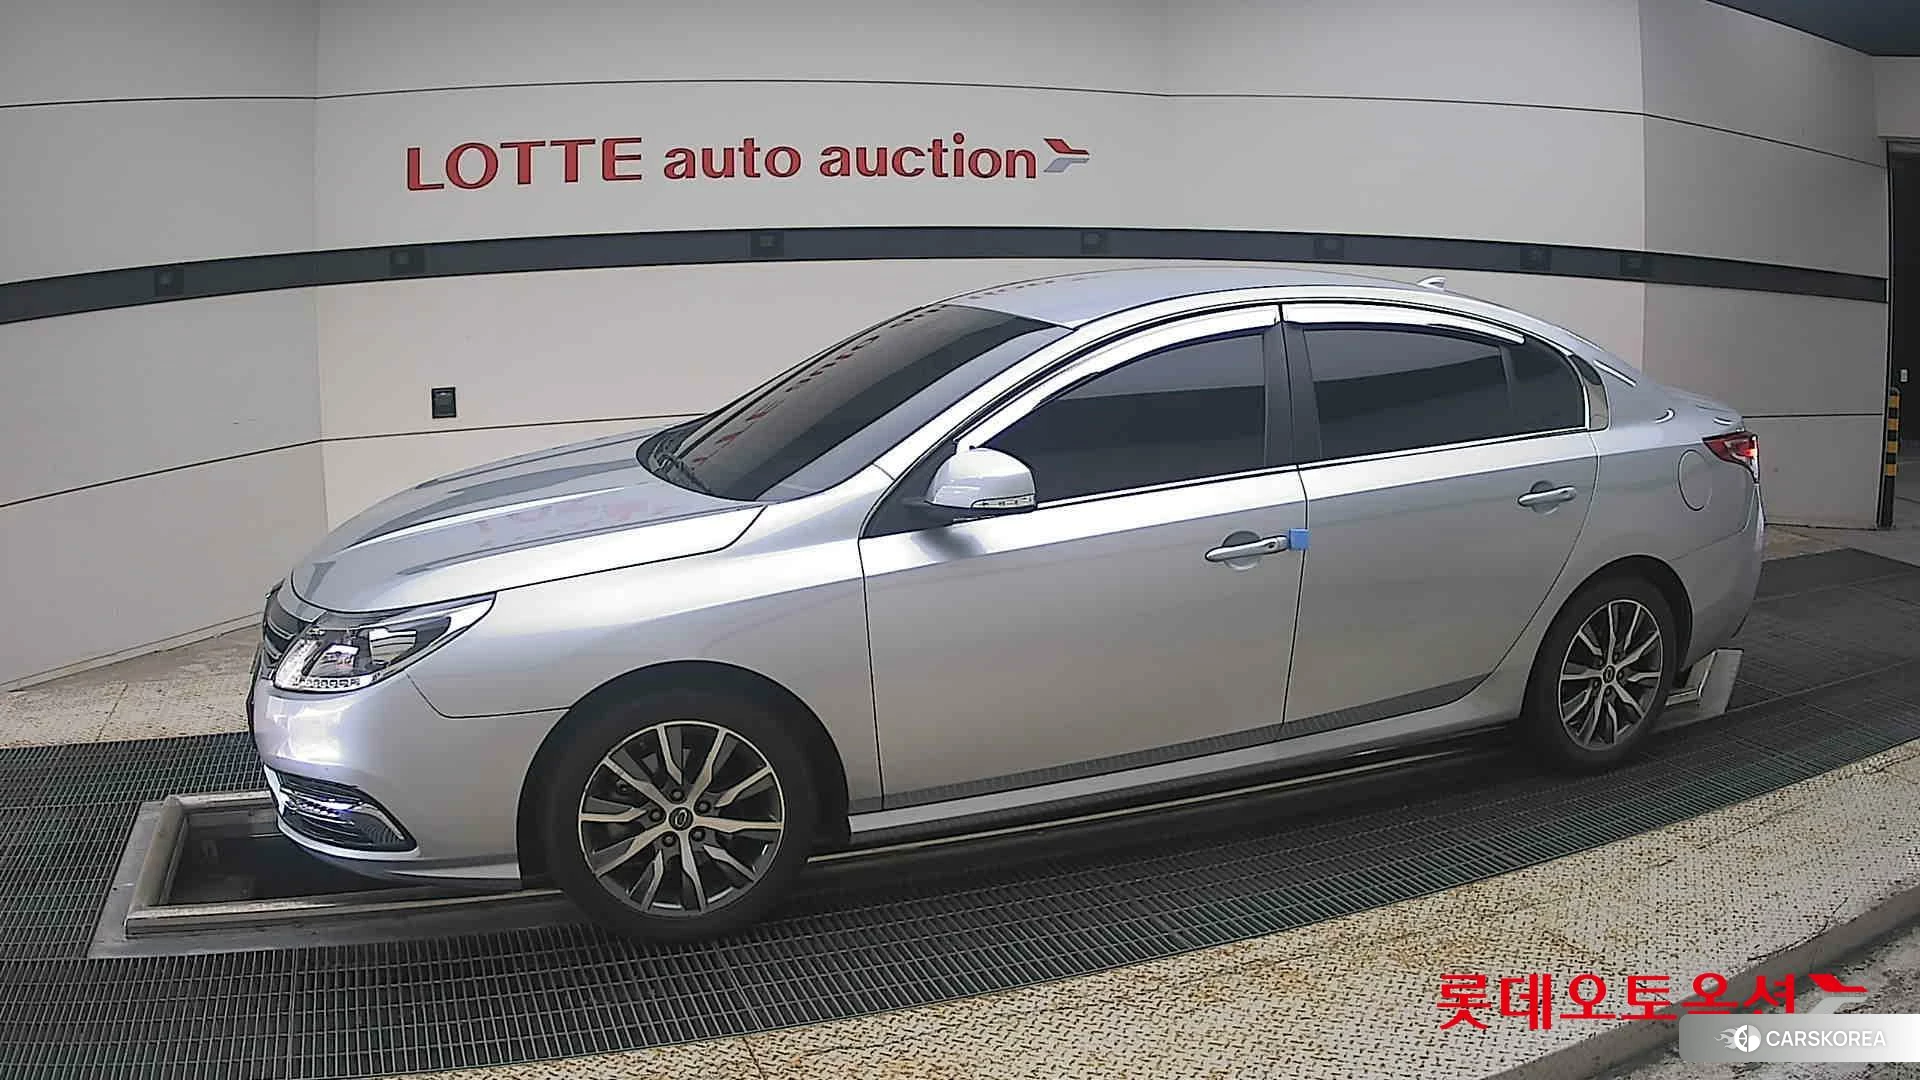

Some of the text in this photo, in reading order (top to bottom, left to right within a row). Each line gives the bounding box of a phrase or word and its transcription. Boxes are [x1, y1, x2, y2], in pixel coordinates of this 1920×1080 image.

[406, 132, 1038, 191] LOTTE auto auction
